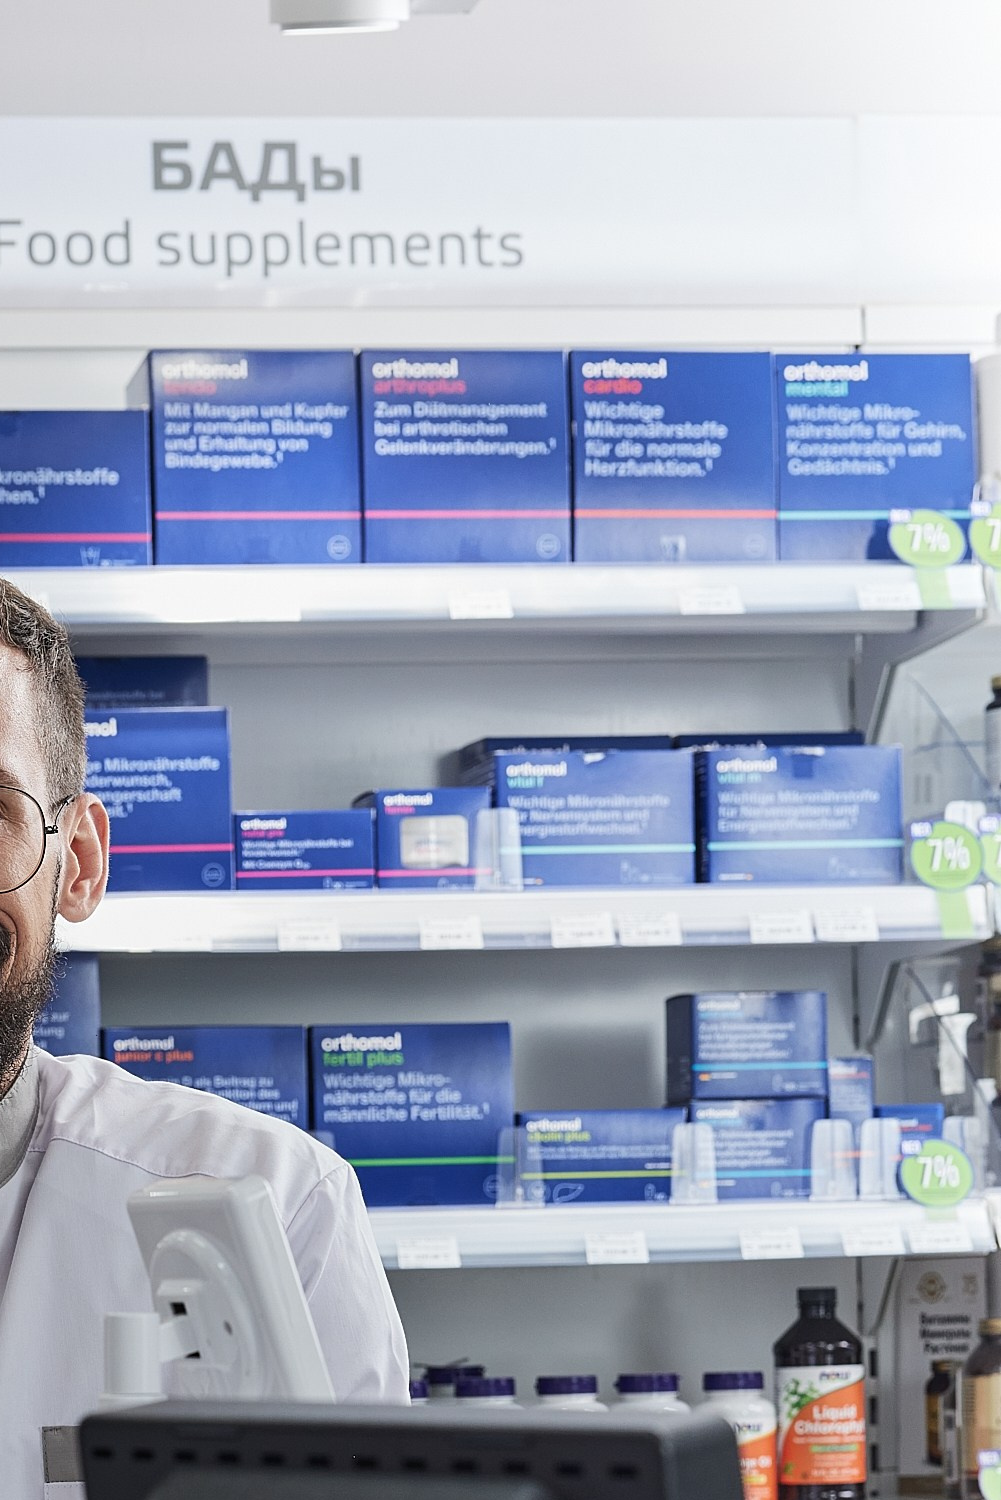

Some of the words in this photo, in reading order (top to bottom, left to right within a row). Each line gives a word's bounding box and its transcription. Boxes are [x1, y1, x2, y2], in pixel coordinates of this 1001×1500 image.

[150, 140, 363, 203] БАДы
[157, 219, 526, 277] supplements
[162, 358, 248, 380] orthomol
[372, 357, 459, 379] orthomol
[581, 357, 668, 380] orthomol
[783, 359, 869, 382] orthomol
[373, 378, 467, 397] arthroplus
[583, 378, 643, 395] cardio
[785, 380, 849, 397] mental
[164, 402, 191, 418] Mit
[193, 401, 259, 421] Mangan
[260, 402, 292, 419] und
[374, 401, 412, 418] Zum
[413, 400, 548, 421] Diätmanagement
[584, 400, 665, 424] Wichtige
[786, 403, 862, 425] Wichtige
[863, 402, 921, 421] Mikro-
[164, 421, 191, 436] zur
[193, 420, 270, 436] normalen
[271, 419, 333, 439] Bildung
[374, 420, 400, 437] bei
[402, 420, 508, 437] arthrotischen
[584, 420, 729, 440] Mikronährstoffe
[786, 421, 875, 440] nährstoffe
[164, 436, 197, 452] und
[198, 436, 276, 454] Erhaltung
[585, 439, 613, 458] für
[614, 439, 645, 458] die
[646, 439, 722, 459] normale
[786, 438, 907, 457] Konzentration
[908, 439, 943, 457] und
[905, 521, 951, 553] 7%
[104, 755, 221, 773] Mikronährstoffe
[505, 760, 568, 778] orthomol
[716, 756, 778, 774] orthomol
[382, 792, 434, 807] orthomol
[240, 816, 287, 831] orthomol
[926, 836, 970, 872] 7%
[113, 1036, 175, 1052] orthomol
[320, 1031, 402, 1052] orthomol
[323, 1051, 364, 1067] fertil
[366, 1051, 405, 1068] plus
[323, 1072, 395, 1091] Wichtige
[397, 1071, 450, 1088] Mikro-
[323, 1088, 406, 1106] nährstoffe
[408, 1088, 432, 1104] für
[434, 1088, 462, 1104] die
[323, 1105, 407, 1123] männliche
[526, 1116, 582, 1133] orthomol
[916, 1154, 960, 1189] 7%
[813, 1403, 857, 1420] Liquid
